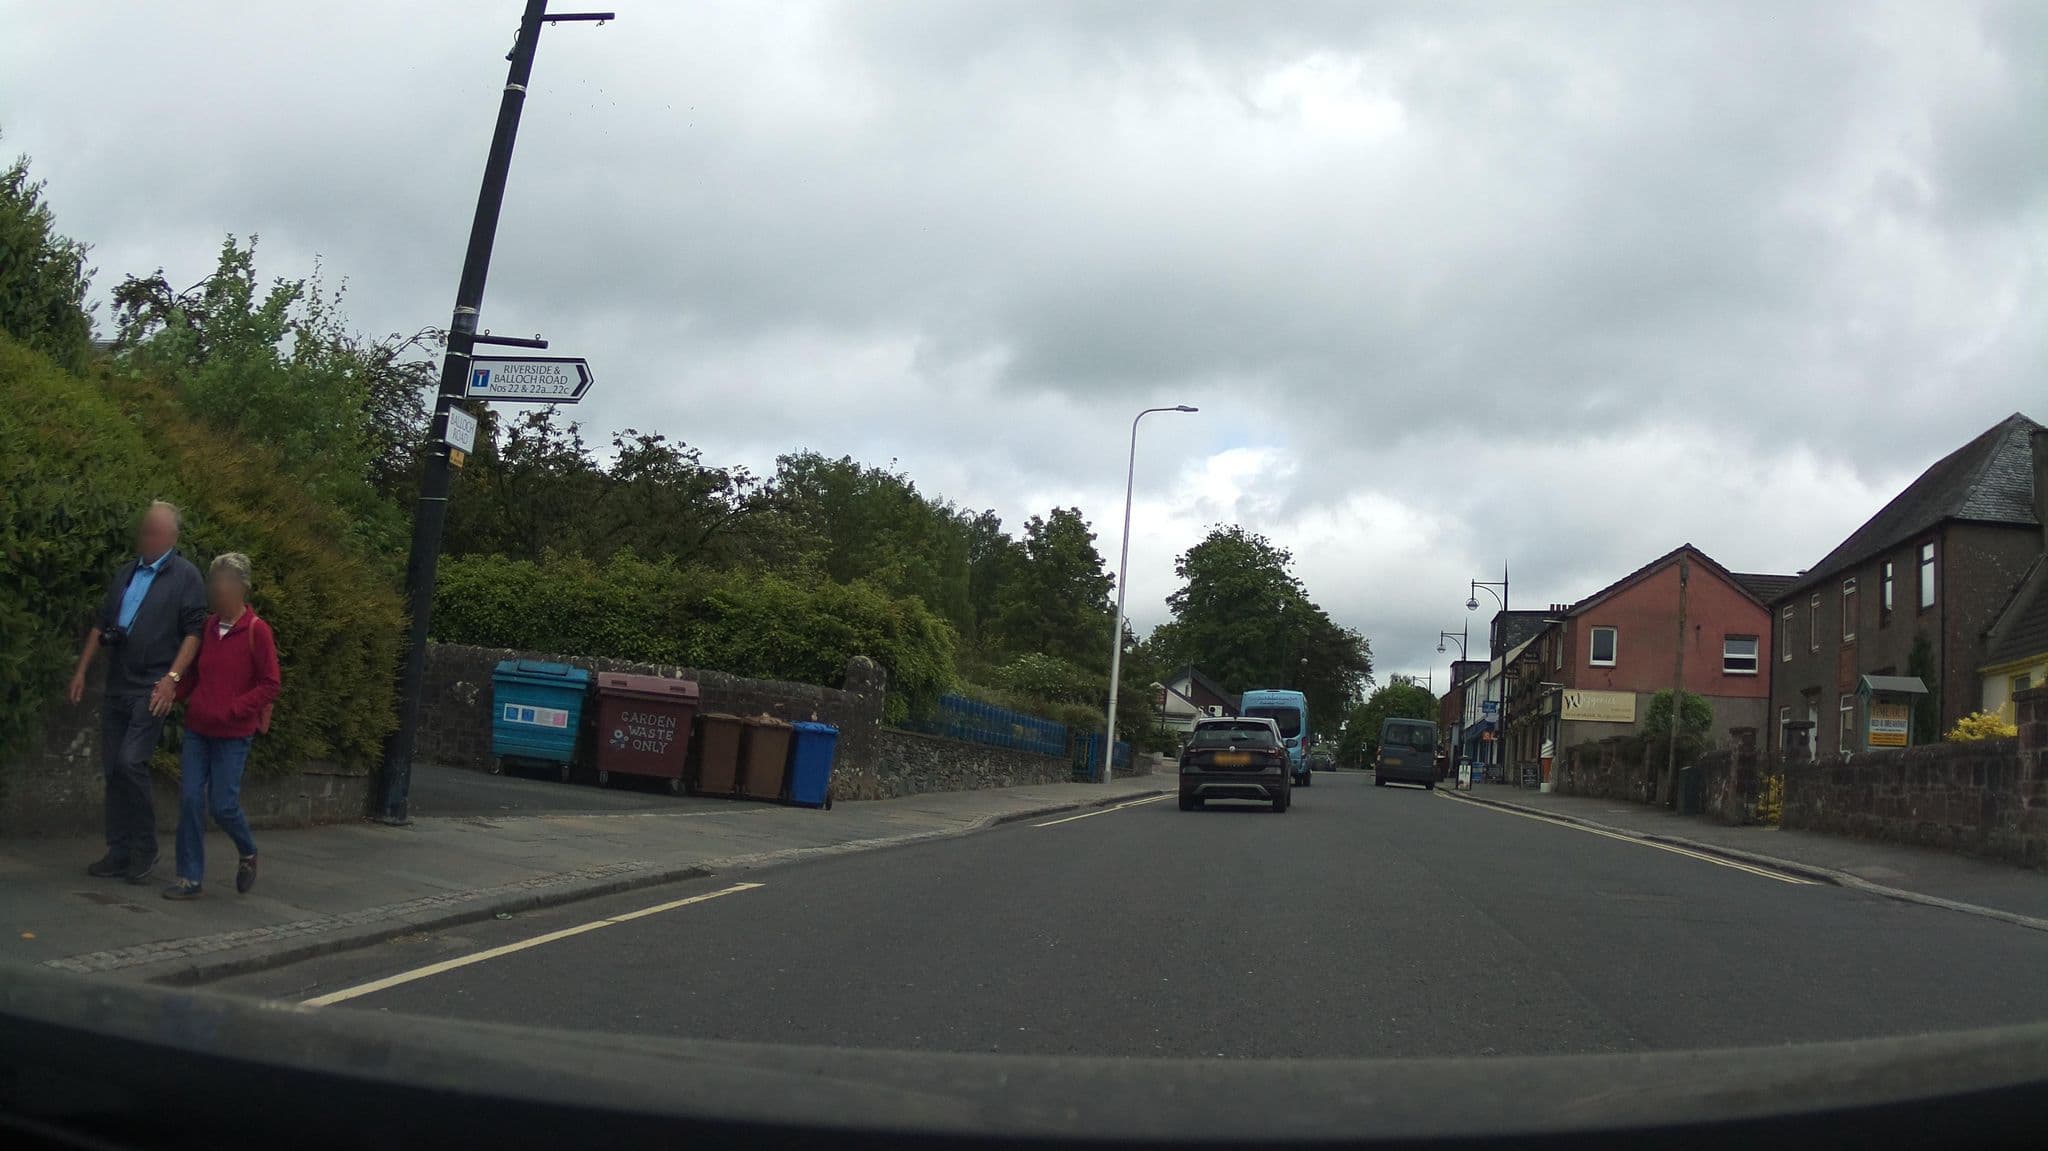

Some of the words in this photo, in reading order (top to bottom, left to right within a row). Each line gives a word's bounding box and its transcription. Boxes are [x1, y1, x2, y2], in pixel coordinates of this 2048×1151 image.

[504, 365, 553, 375] RIVERSIDE
[553, 366, 561, 375] &
[494, 374, 538, 384] BALLOCH
[539, 375, 568, 385] ROAD
[489, 383, 507, 392] Nos
[507, 384, 519, 393] 22
[520, 385, 528, 393] &
[621, 711, 676, 728] GARDEN
[628, 725, 674, 742] WASTE
[632, 739, 668, 754] ONLY
